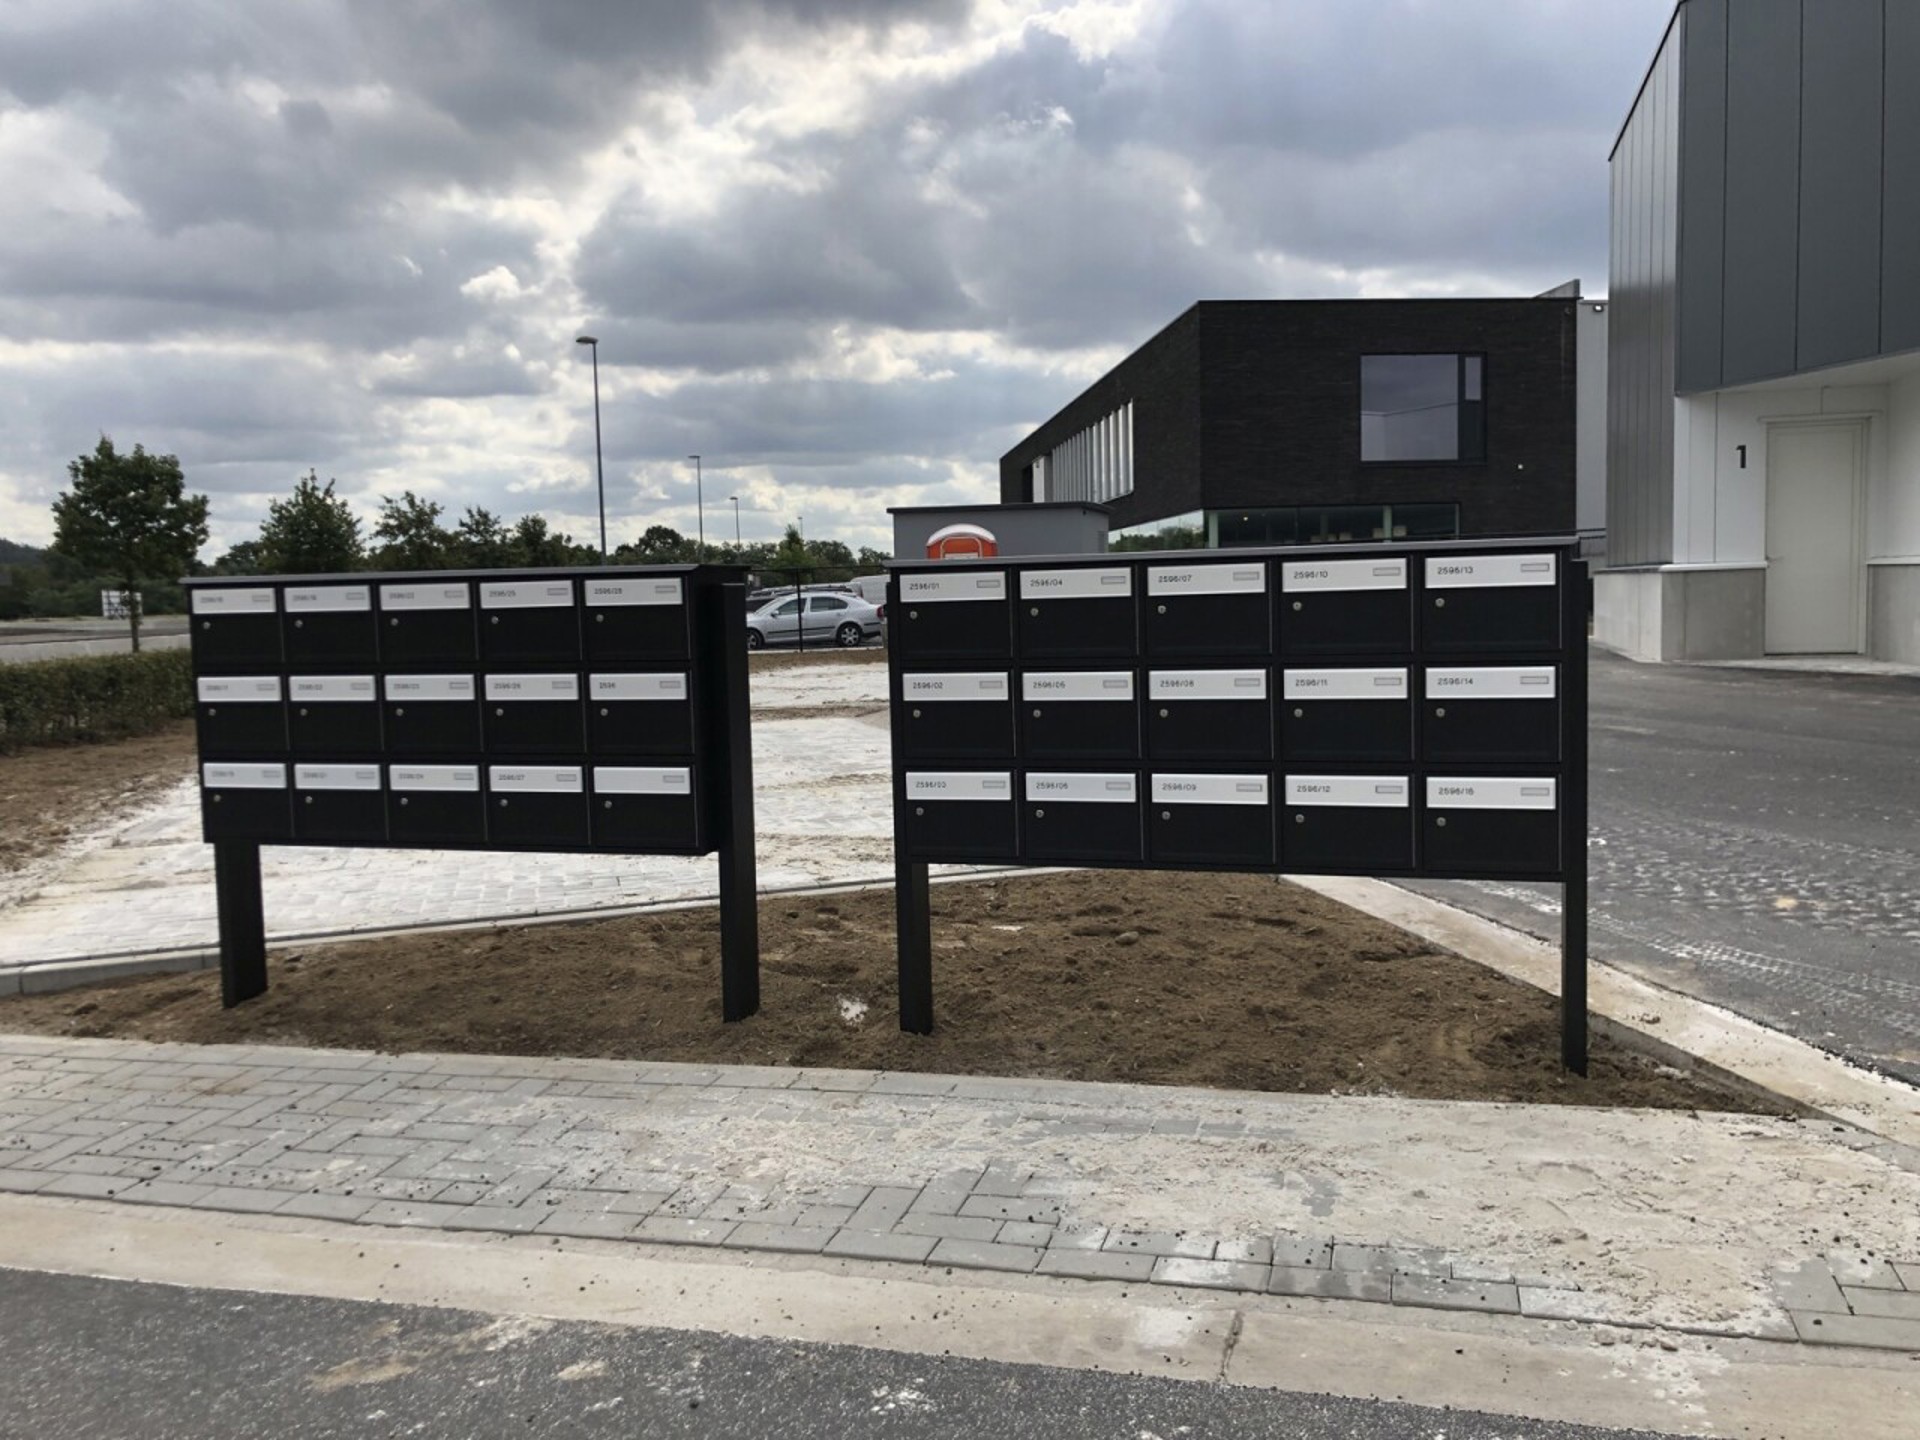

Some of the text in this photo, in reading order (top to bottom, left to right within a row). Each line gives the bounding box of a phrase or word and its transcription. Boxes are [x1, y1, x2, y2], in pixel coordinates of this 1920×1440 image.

[1736, 445, 1746, 469] 1
[1294, 570, 1328, 579] 2596/10
[1437, 566, 1473, 575] 2596/13
[1030, 579, 1062, 587] 2596/04
[1158, 574, 1192, 583] 2596/07
[1296, 679, 1327, 687] 2596/11
[1437, 678, 1473, 686] 2596/14
